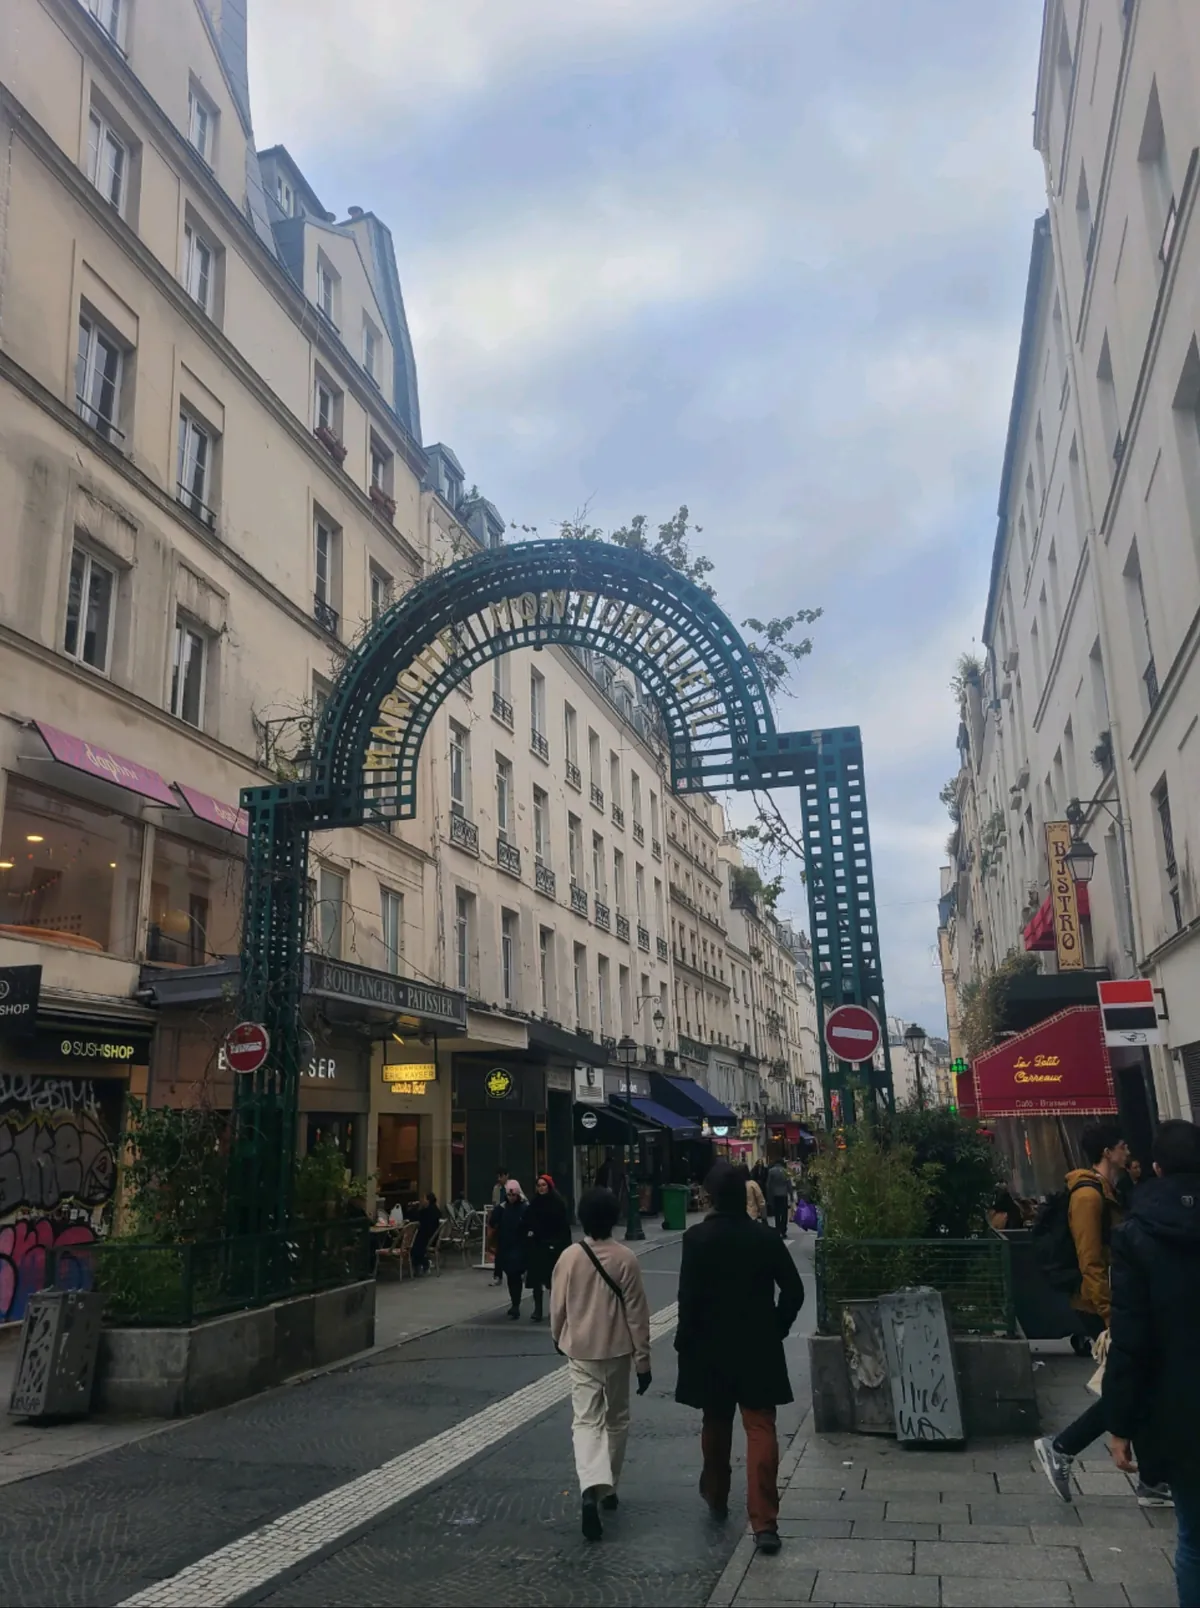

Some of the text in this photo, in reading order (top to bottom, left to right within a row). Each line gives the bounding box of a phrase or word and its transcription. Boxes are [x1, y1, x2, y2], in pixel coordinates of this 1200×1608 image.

[488, 589, 723, 737] MONTORGUEIL
[1052, 841, 1076, 950] BISTRO
[323, 964, 397, 1004] BOULANGER
[0, 1003, 30, 1016] SHOP
[407, 986, 454, 1017] PATISSIER
[405, 1070, 434, 1080] KAYSER
[1014, 1071, 1063, 1083] Carreaux
